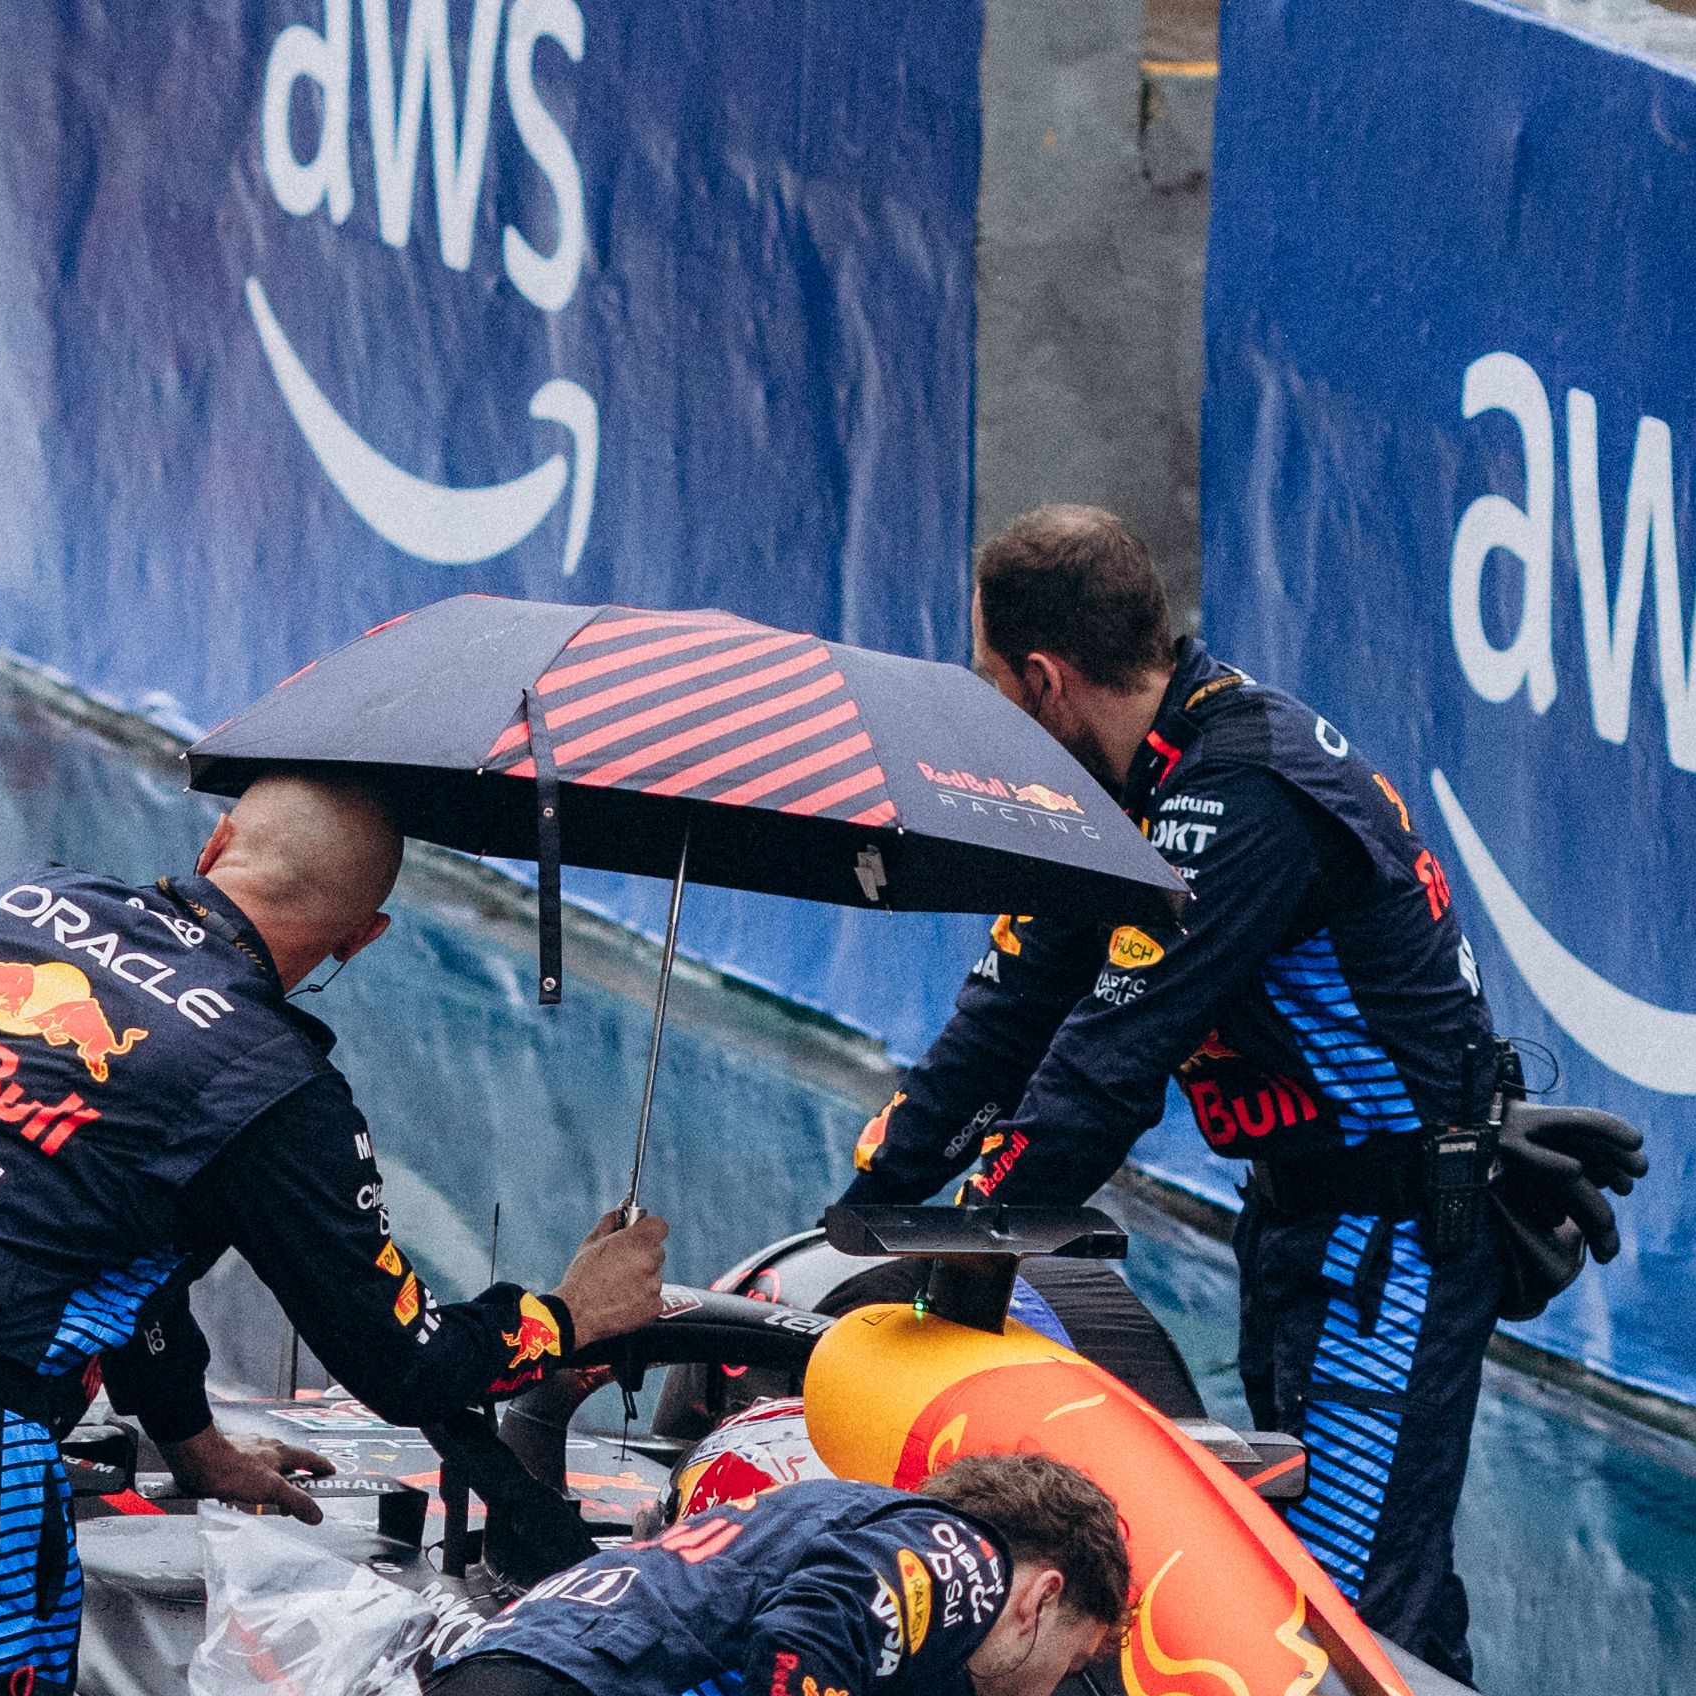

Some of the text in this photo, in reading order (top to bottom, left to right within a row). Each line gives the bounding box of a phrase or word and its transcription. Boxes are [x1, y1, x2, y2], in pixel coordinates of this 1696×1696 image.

[917, 761, 1011, 799] Red Bull
[938, 793, 1102, 841] RACING
[944, 1101, 1002, 1160] sparco
[931, 1523, 995, 1625] claro
[870, 1578, 903, 1677] VISA
